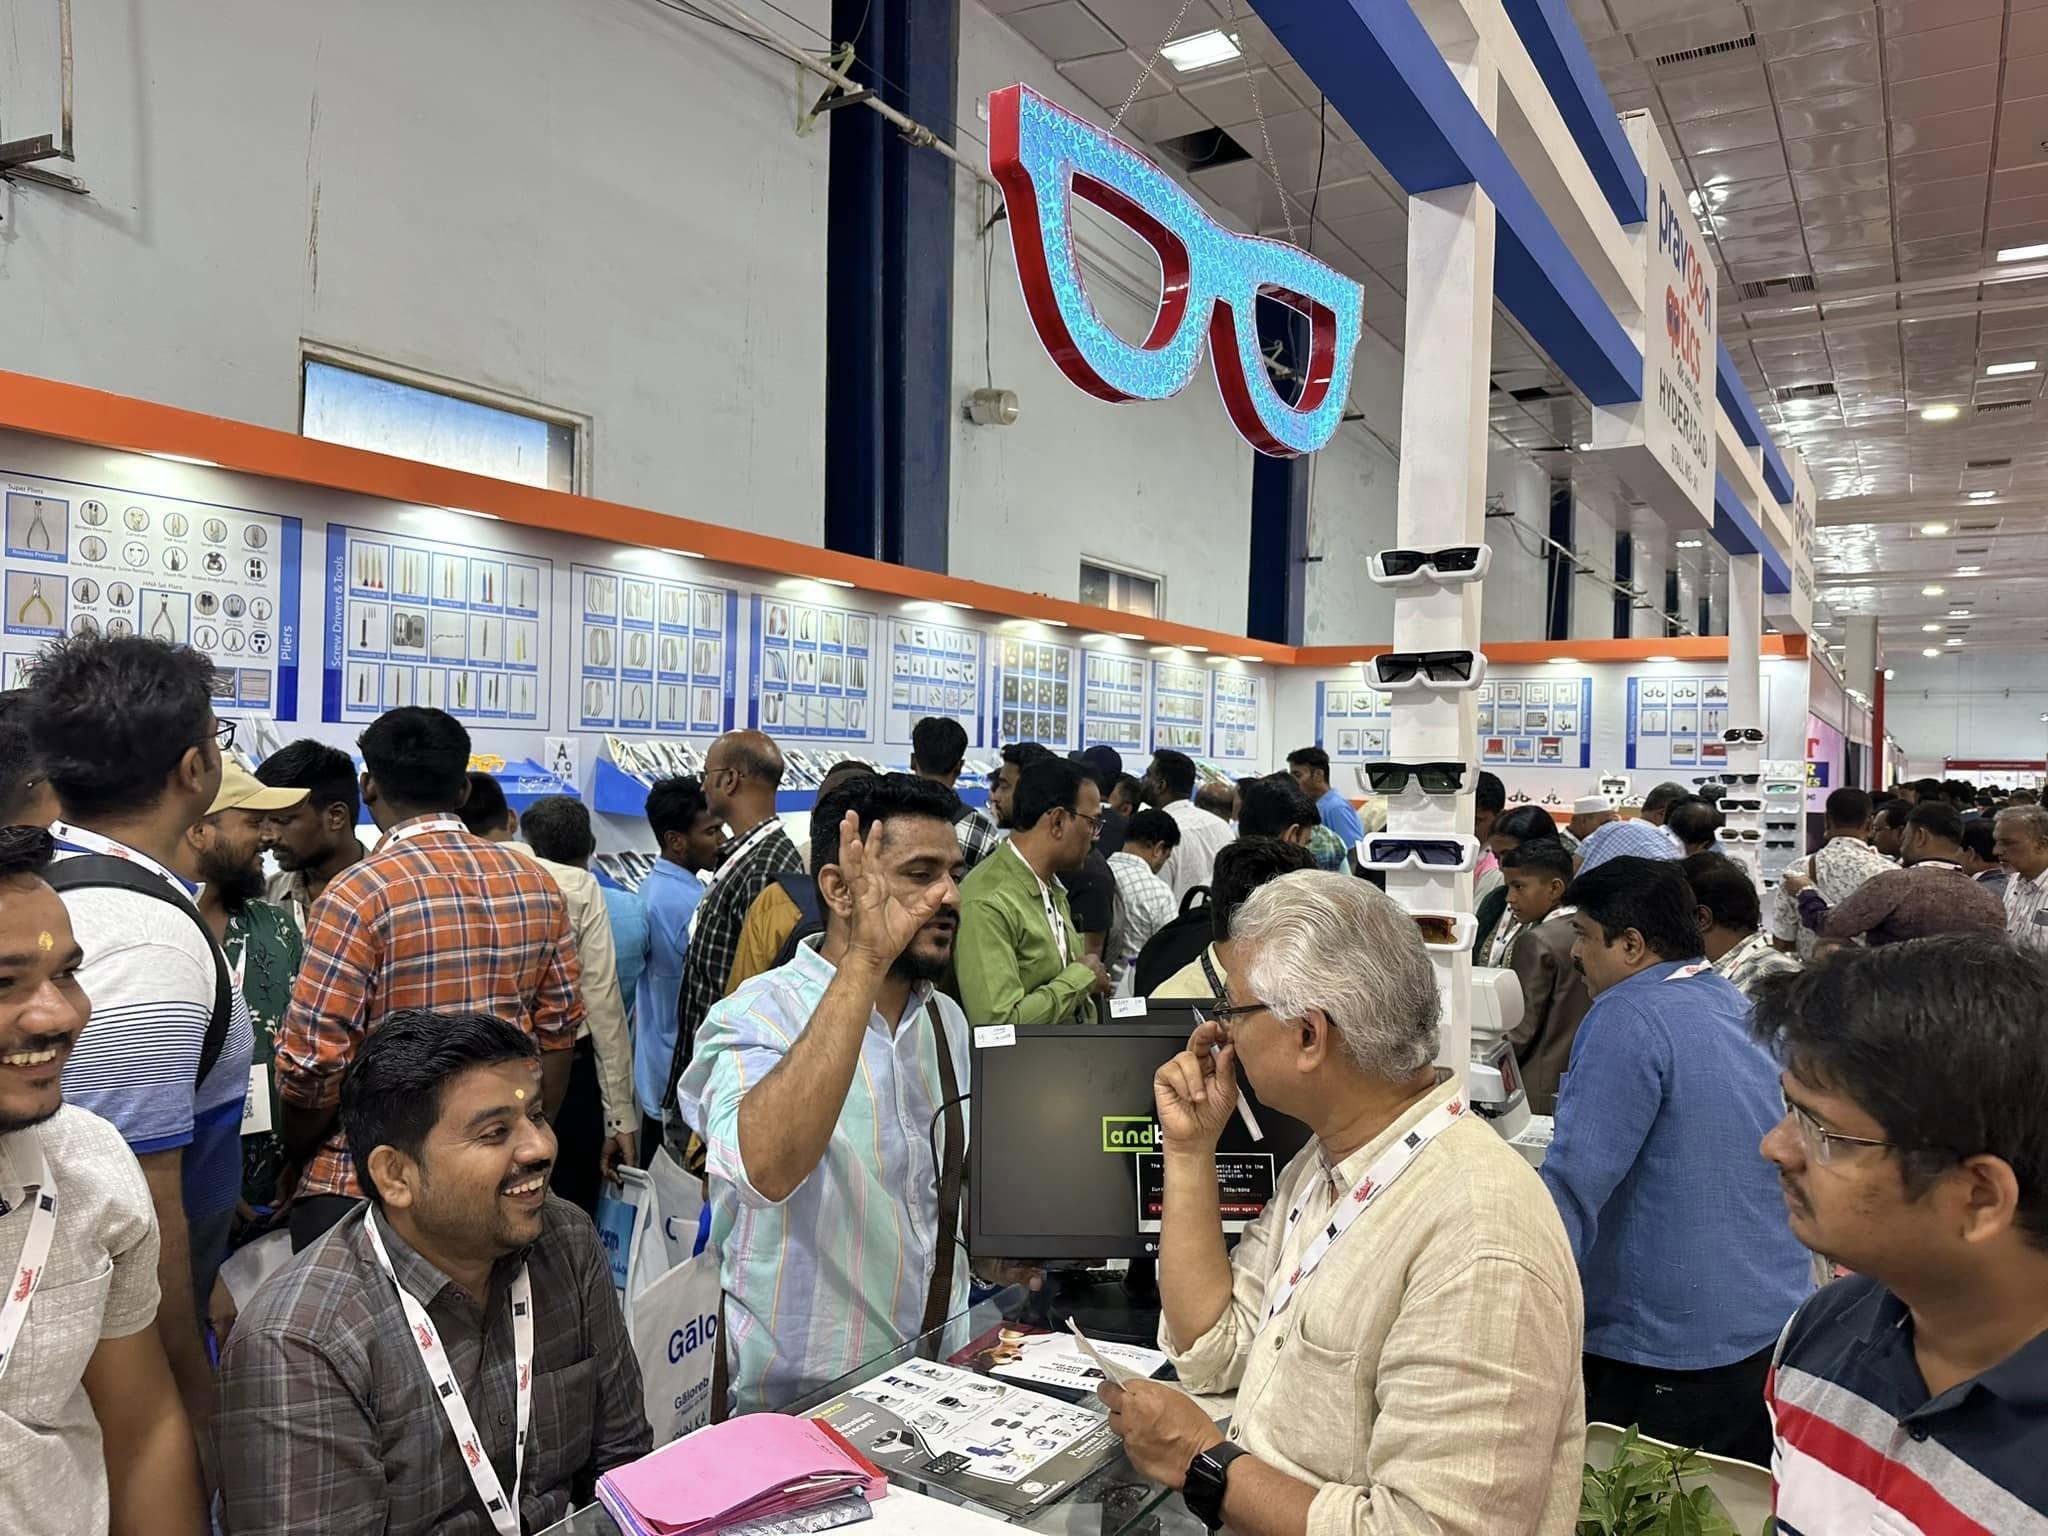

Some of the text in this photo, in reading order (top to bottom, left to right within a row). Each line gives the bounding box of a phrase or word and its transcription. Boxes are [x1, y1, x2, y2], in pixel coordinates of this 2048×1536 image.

[1659, 182, 1711, 335] praveen
[281, 625, 293, 661] Pliers
[331, 556, 344, 666] Screw Drivers & Tools
[557, 743, 568, 760] A
